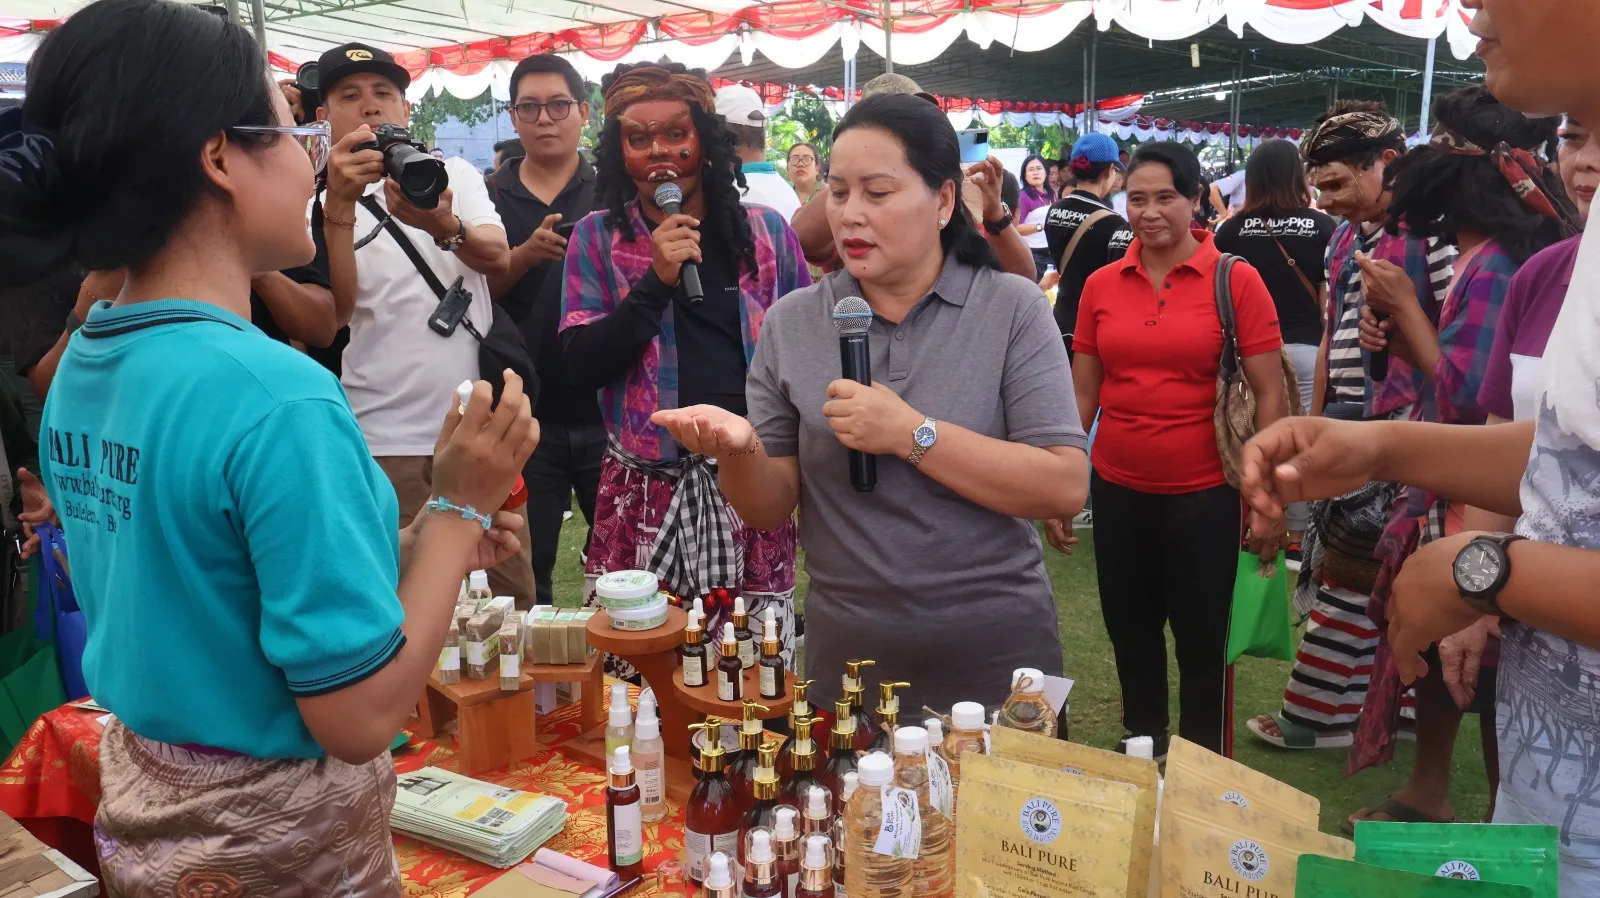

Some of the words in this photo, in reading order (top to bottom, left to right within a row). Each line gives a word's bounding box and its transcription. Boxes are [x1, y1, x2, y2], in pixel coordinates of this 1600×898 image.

[100, 438, 140, 485] PURE
[1022, 799, 1040, 818] BALI
[1042, 800, 1060, 825] PURE
[1001, 840, 1032, 859] BALI
[1038, 850, 1077, 872] PURE
[1230, 840, 1248, 856] BALI
[1203, 870, 1240, 894] BALI
[1441, 863, 1456, 877] ALI
